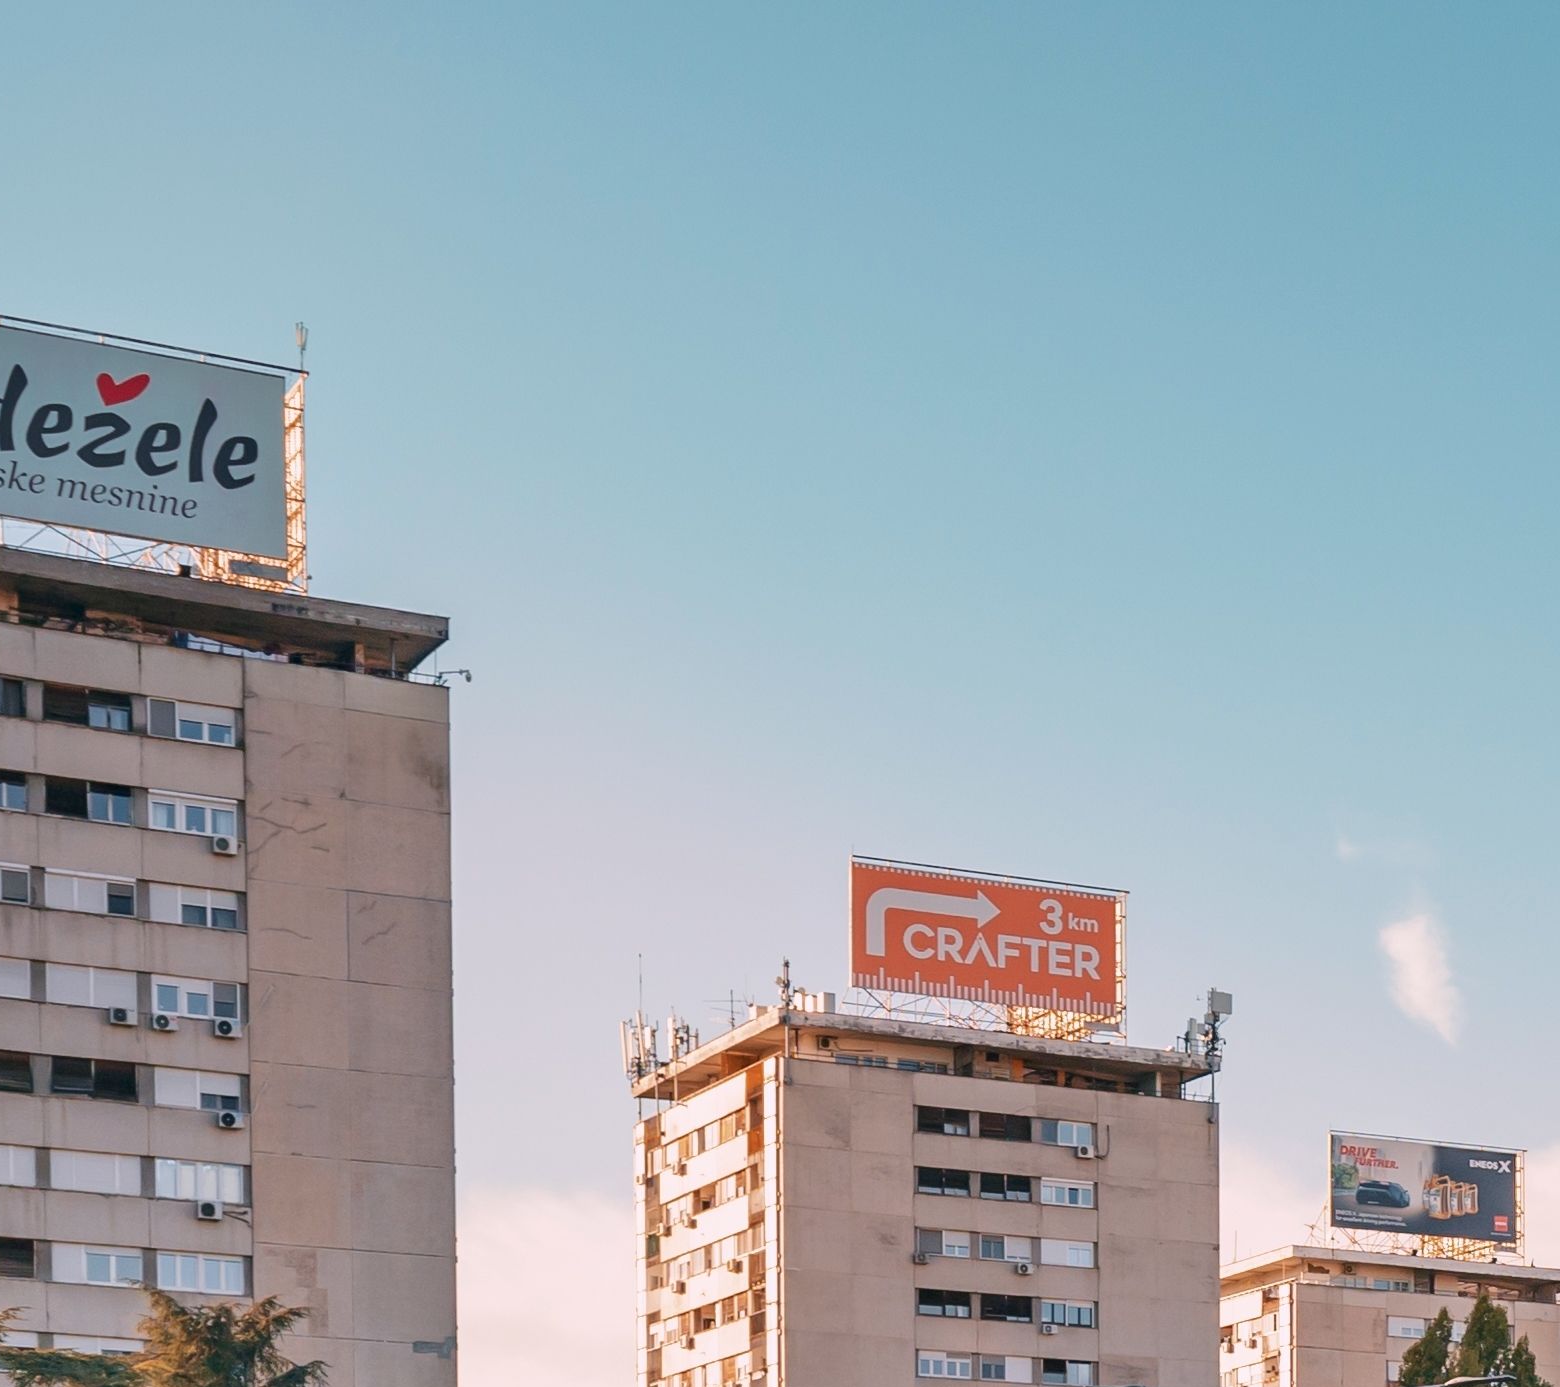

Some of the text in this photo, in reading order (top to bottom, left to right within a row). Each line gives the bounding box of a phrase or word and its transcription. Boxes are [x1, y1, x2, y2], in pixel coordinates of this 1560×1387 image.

[56, 475, 199, 519] mesnine
[1039, 898, 1099, 935] 3 km
[902, 923, 1102, 981] CRAFTER
[1340, 1145, 1377, 1158] DRIVE
